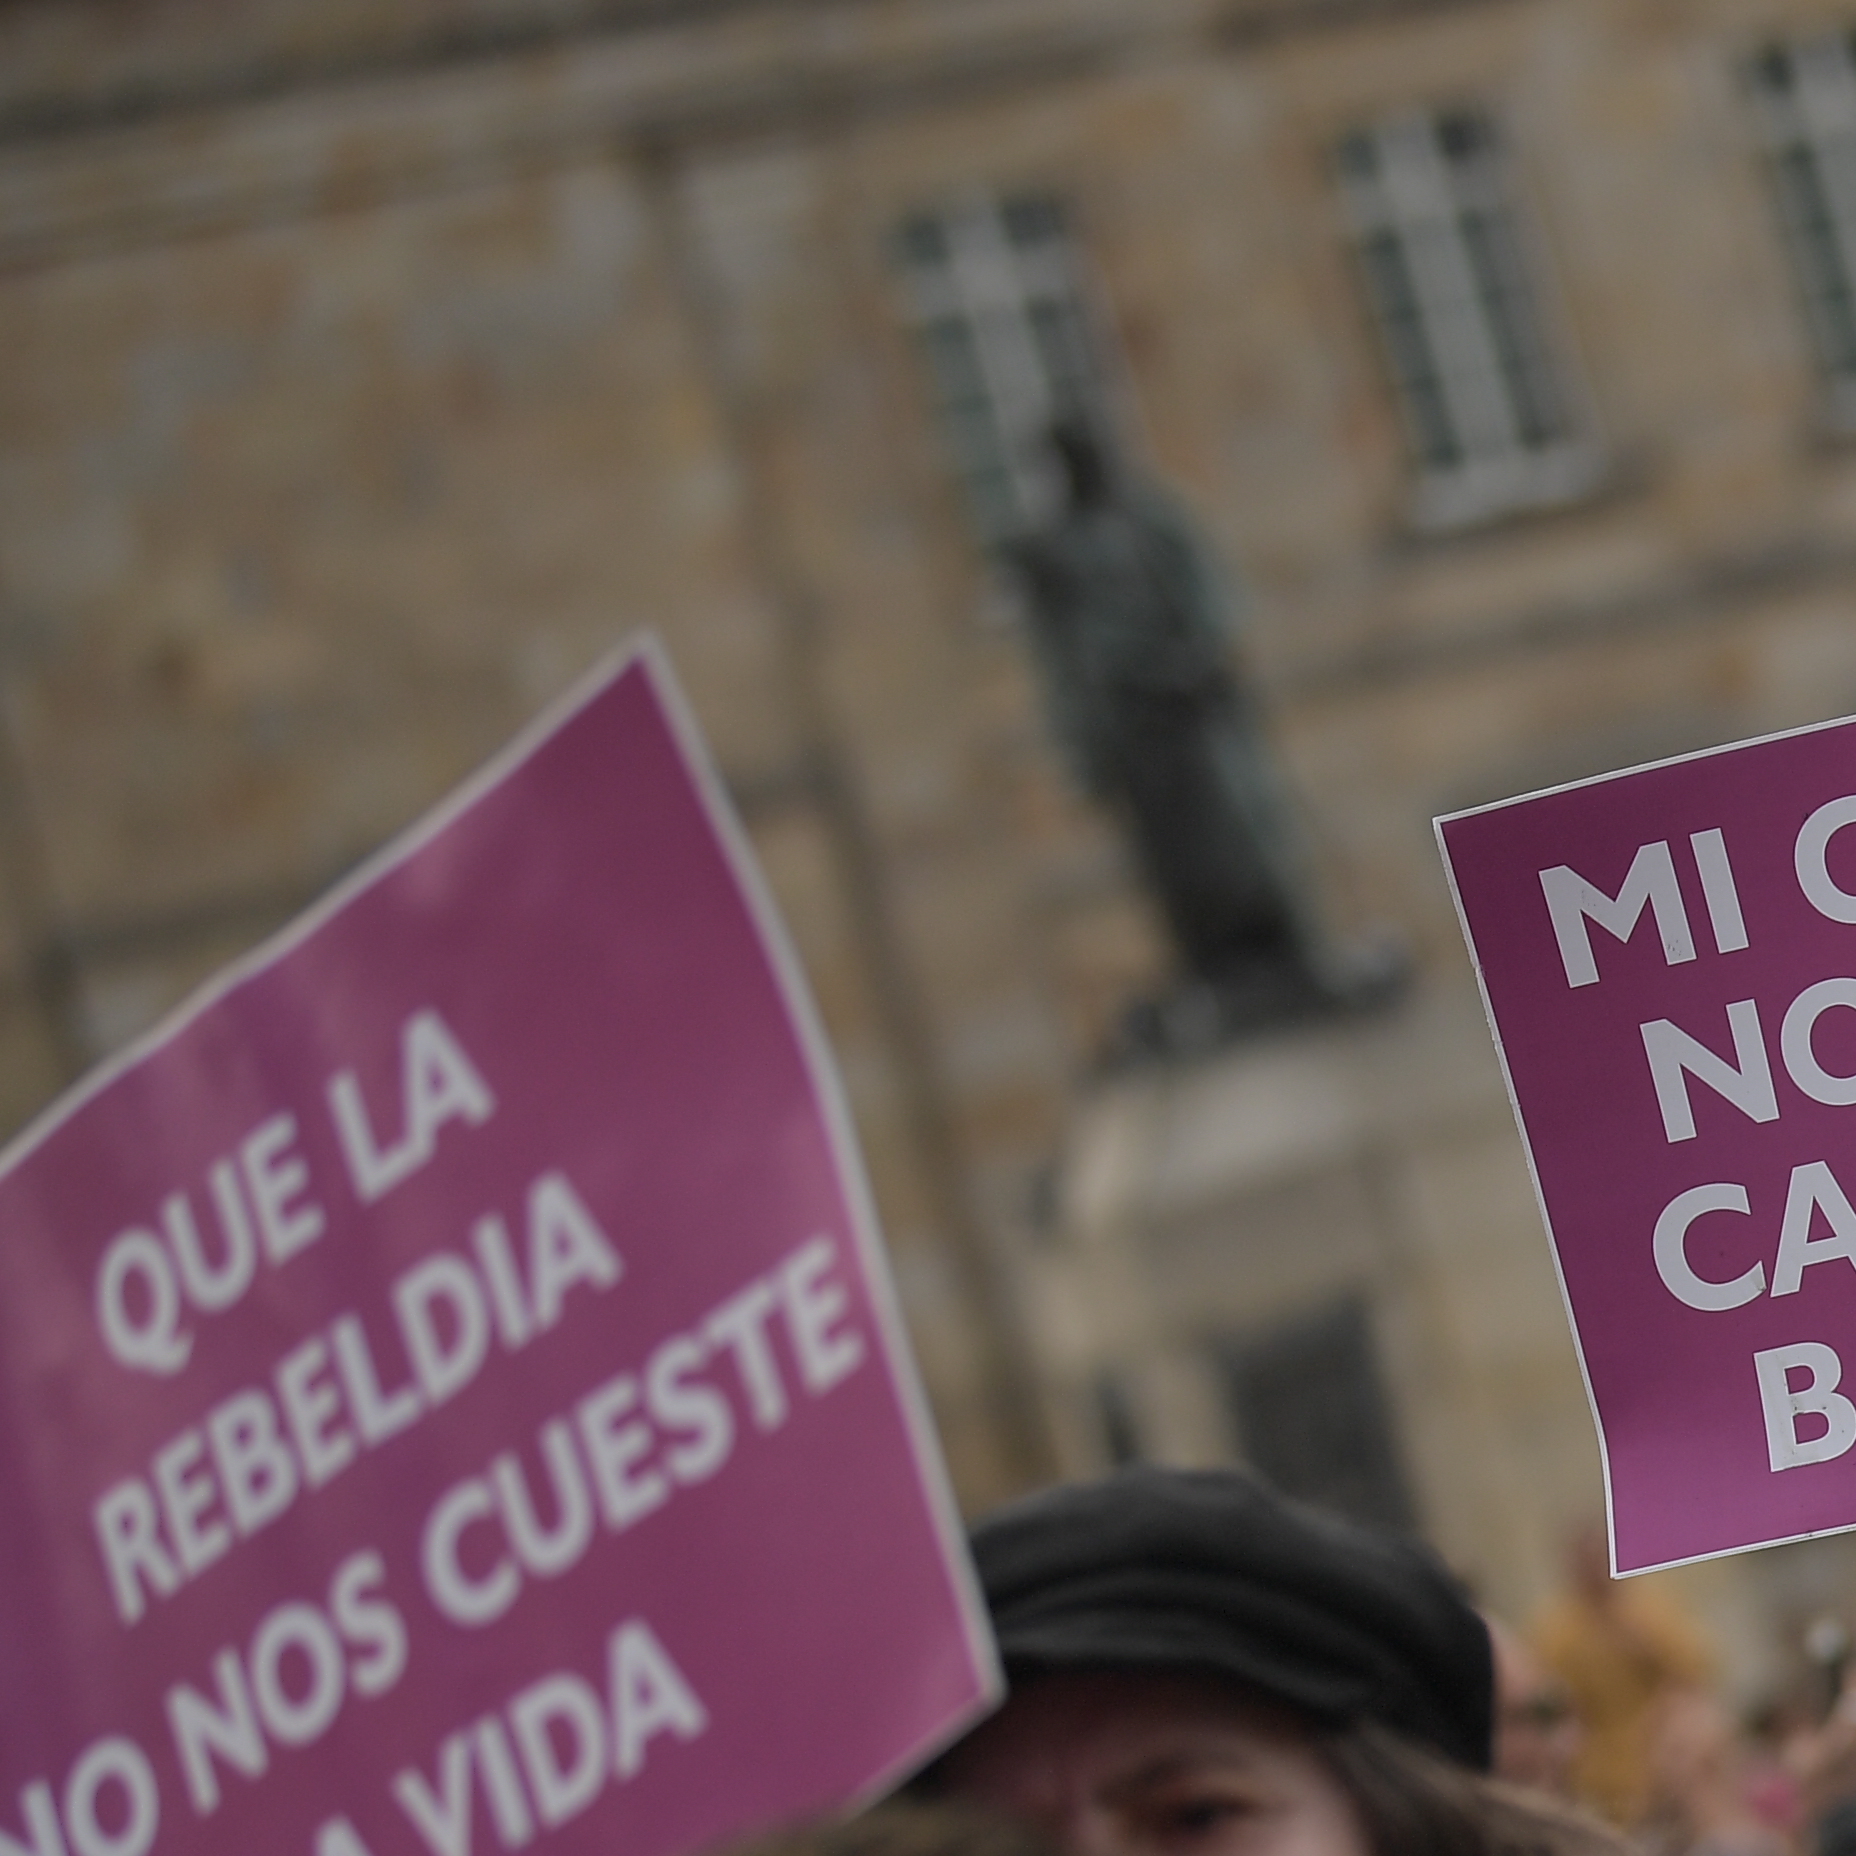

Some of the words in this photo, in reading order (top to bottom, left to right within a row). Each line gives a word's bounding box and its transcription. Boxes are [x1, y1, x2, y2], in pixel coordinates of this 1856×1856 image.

[1538, 828, 1750, 988] MI
[92, 1171, 623, 1625] REBELDIA
[94, 1114, 326, 1377] QUE
[325, 1007, 496, 1206] LA
[167, 1549, 411, 1817] NOS
[420, 1237, 868, 1628] CUESTE
